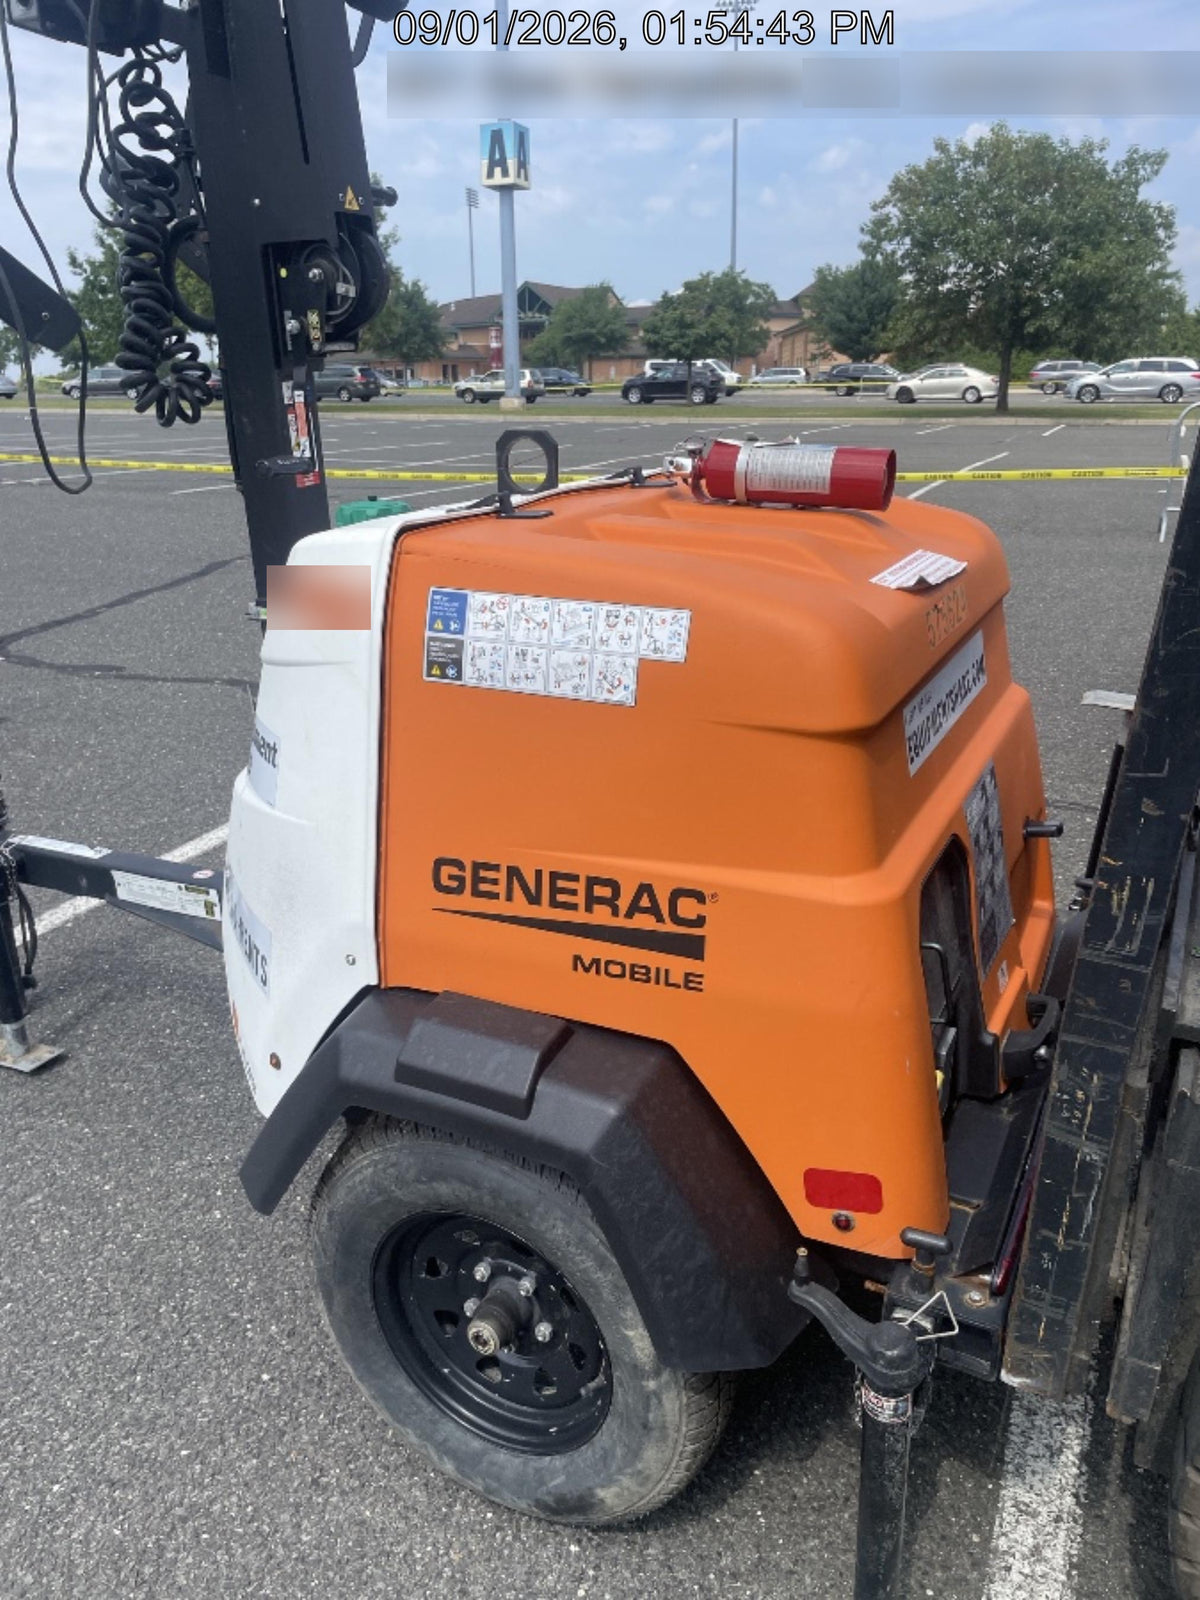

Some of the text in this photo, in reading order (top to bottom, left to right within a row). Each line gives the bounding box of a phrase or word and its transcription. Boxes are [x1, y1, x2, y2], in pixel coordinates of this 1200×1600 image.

[486, 128, 510, 180] A
[516, 131, 529, 182] A
[431, 856, 707, 929] GENERAC
[571, 953, 705, 993] MOBILE
